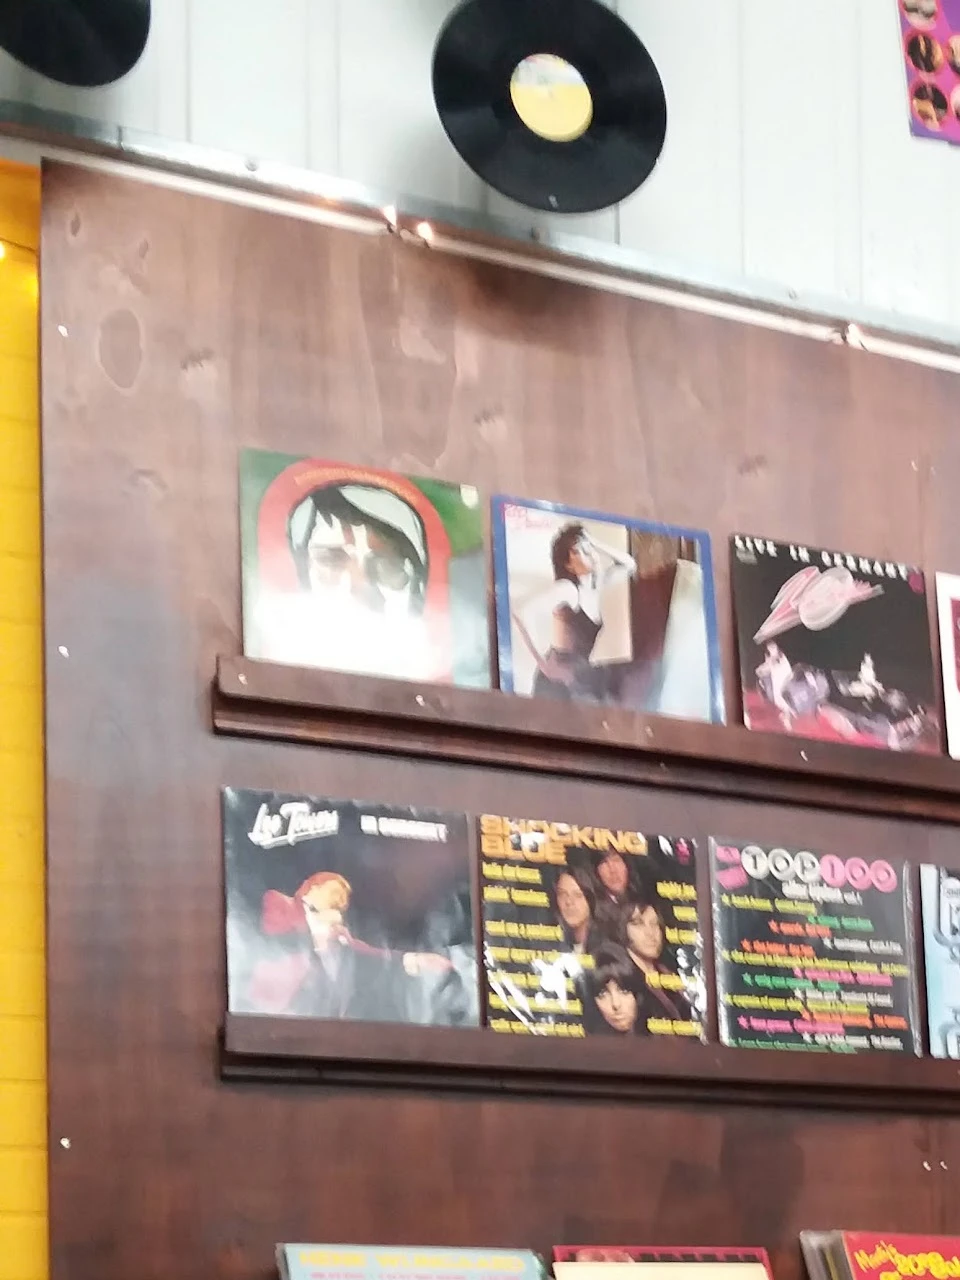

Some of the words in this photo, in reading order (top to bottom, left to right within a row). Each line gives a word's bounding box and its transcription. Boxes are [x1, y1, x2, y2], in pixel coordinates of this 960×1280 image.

[479, 813, 649, 857] SHOCKING
[480, 833, 569, 866] BLUE
[740, 845, 821, 884] TOP
[819, 853, 898, 893] 100
